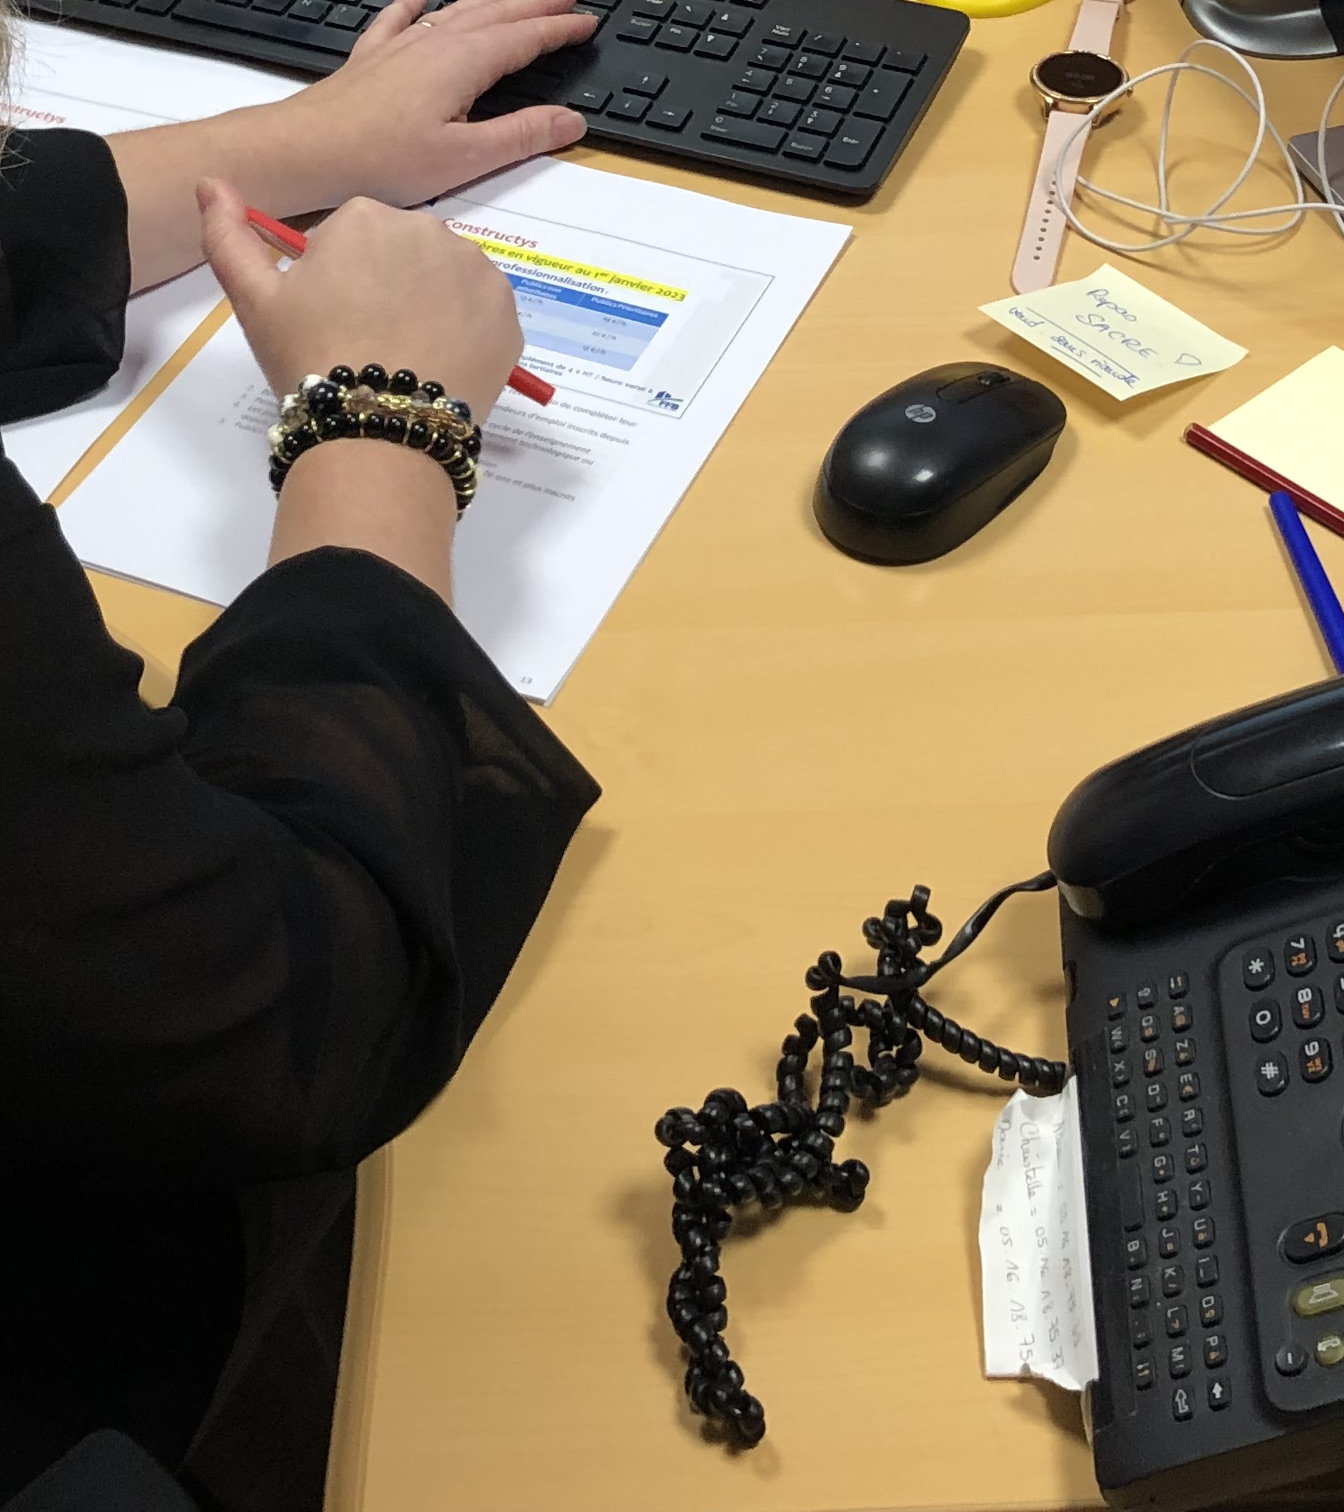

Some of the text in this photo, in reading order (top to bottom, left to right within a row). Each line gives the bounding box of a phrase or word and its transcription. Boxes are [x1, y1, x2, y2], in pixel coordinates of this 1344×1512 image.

[443, 217, 539, 249] Constructys
[508, 250, 524, 261] en
[526, 252, 574, 272] vigueur
[575, 266, 591, 277] au
[607, 273, 653, 293] janvier
[655, 287, 687, 302] 2023
[1290, 938, 1305, 950] 7
[1297, 987, 1312, 1004] 8
[1255, 1009, 1272, 1025] 0
[1304, 1040, 1320, 1056] 9
